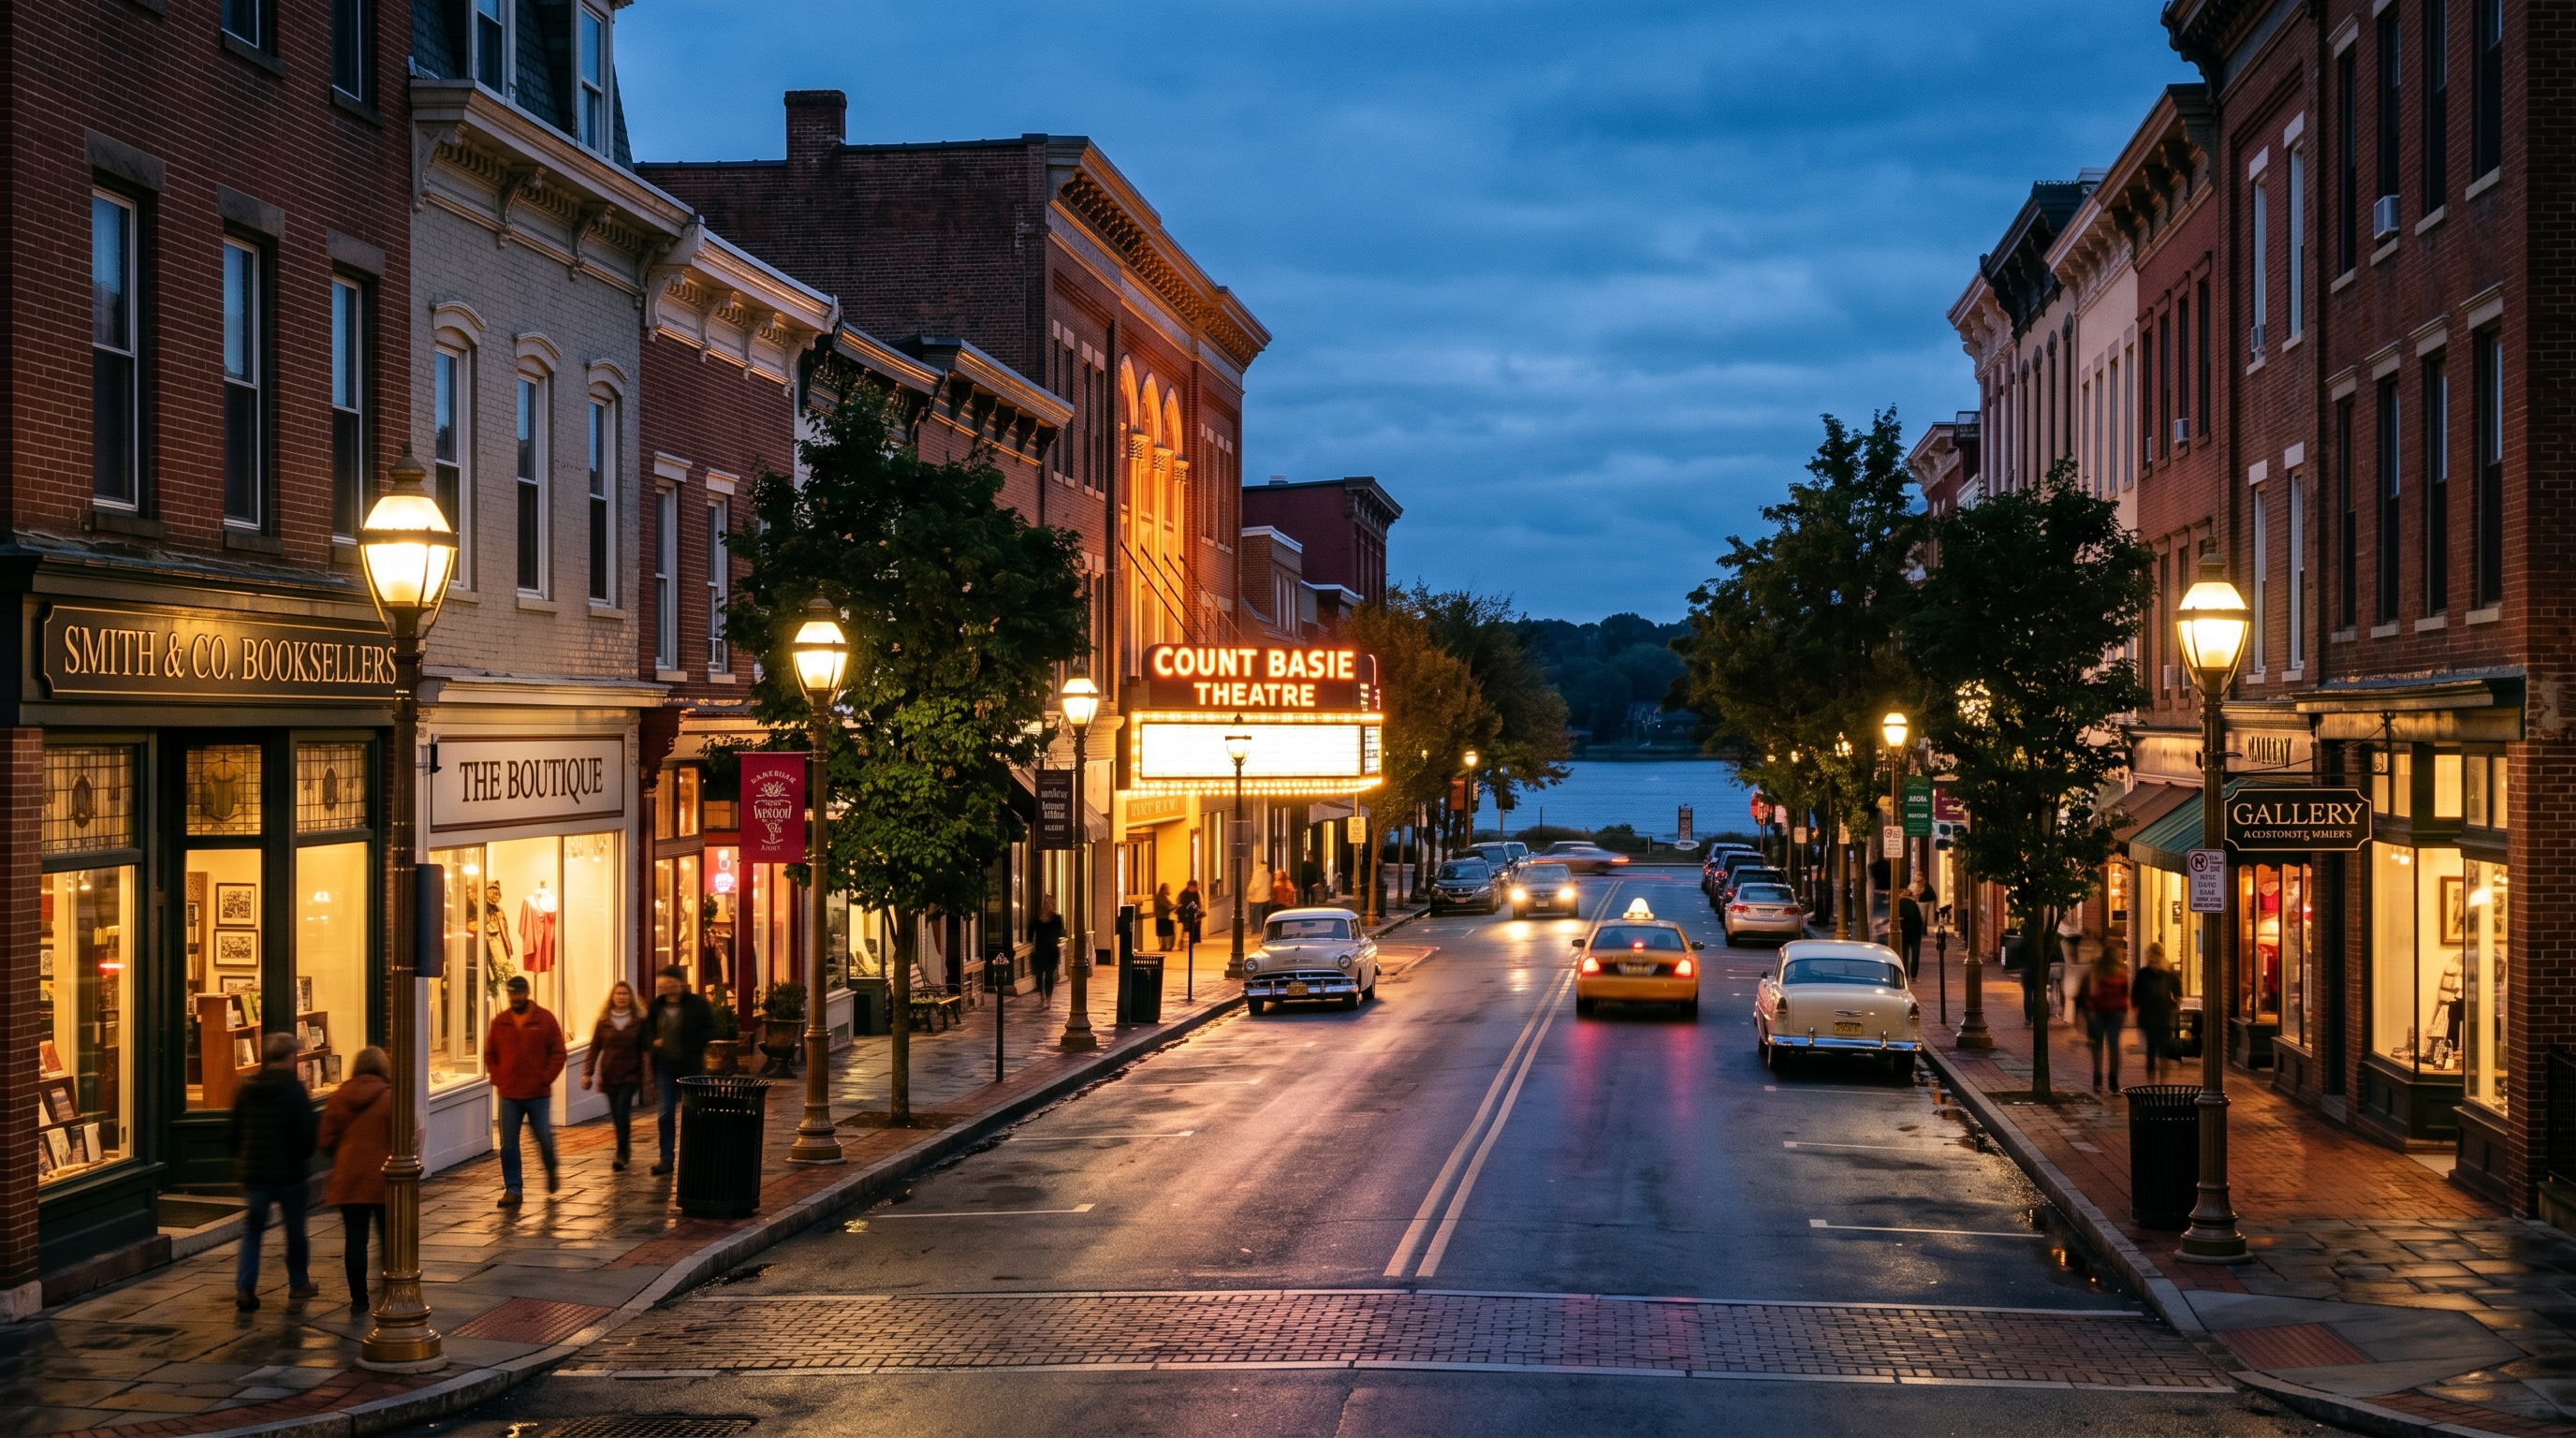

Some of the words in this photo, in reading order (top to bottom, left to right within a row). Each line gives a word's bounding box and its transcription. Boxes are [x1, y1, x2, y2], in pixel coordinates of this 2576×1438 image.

[64, 624, 157, 677] SMITH
[163, 631, 185, 679] &
[191, 633, 234, 681] CO.
[241, 637, 397, 685] BOOKSELLERS
[1153, 646, 1258, 678] COUNT
[1268, 650, 1354, 679] BASIE
[1193, 682, 1316, 708] THEATRE
[459, 760, 503, 803] THE
[506, 756, 604, 805] BOUTIQUE
[2232, 802, 2364, 826] GALLERY
